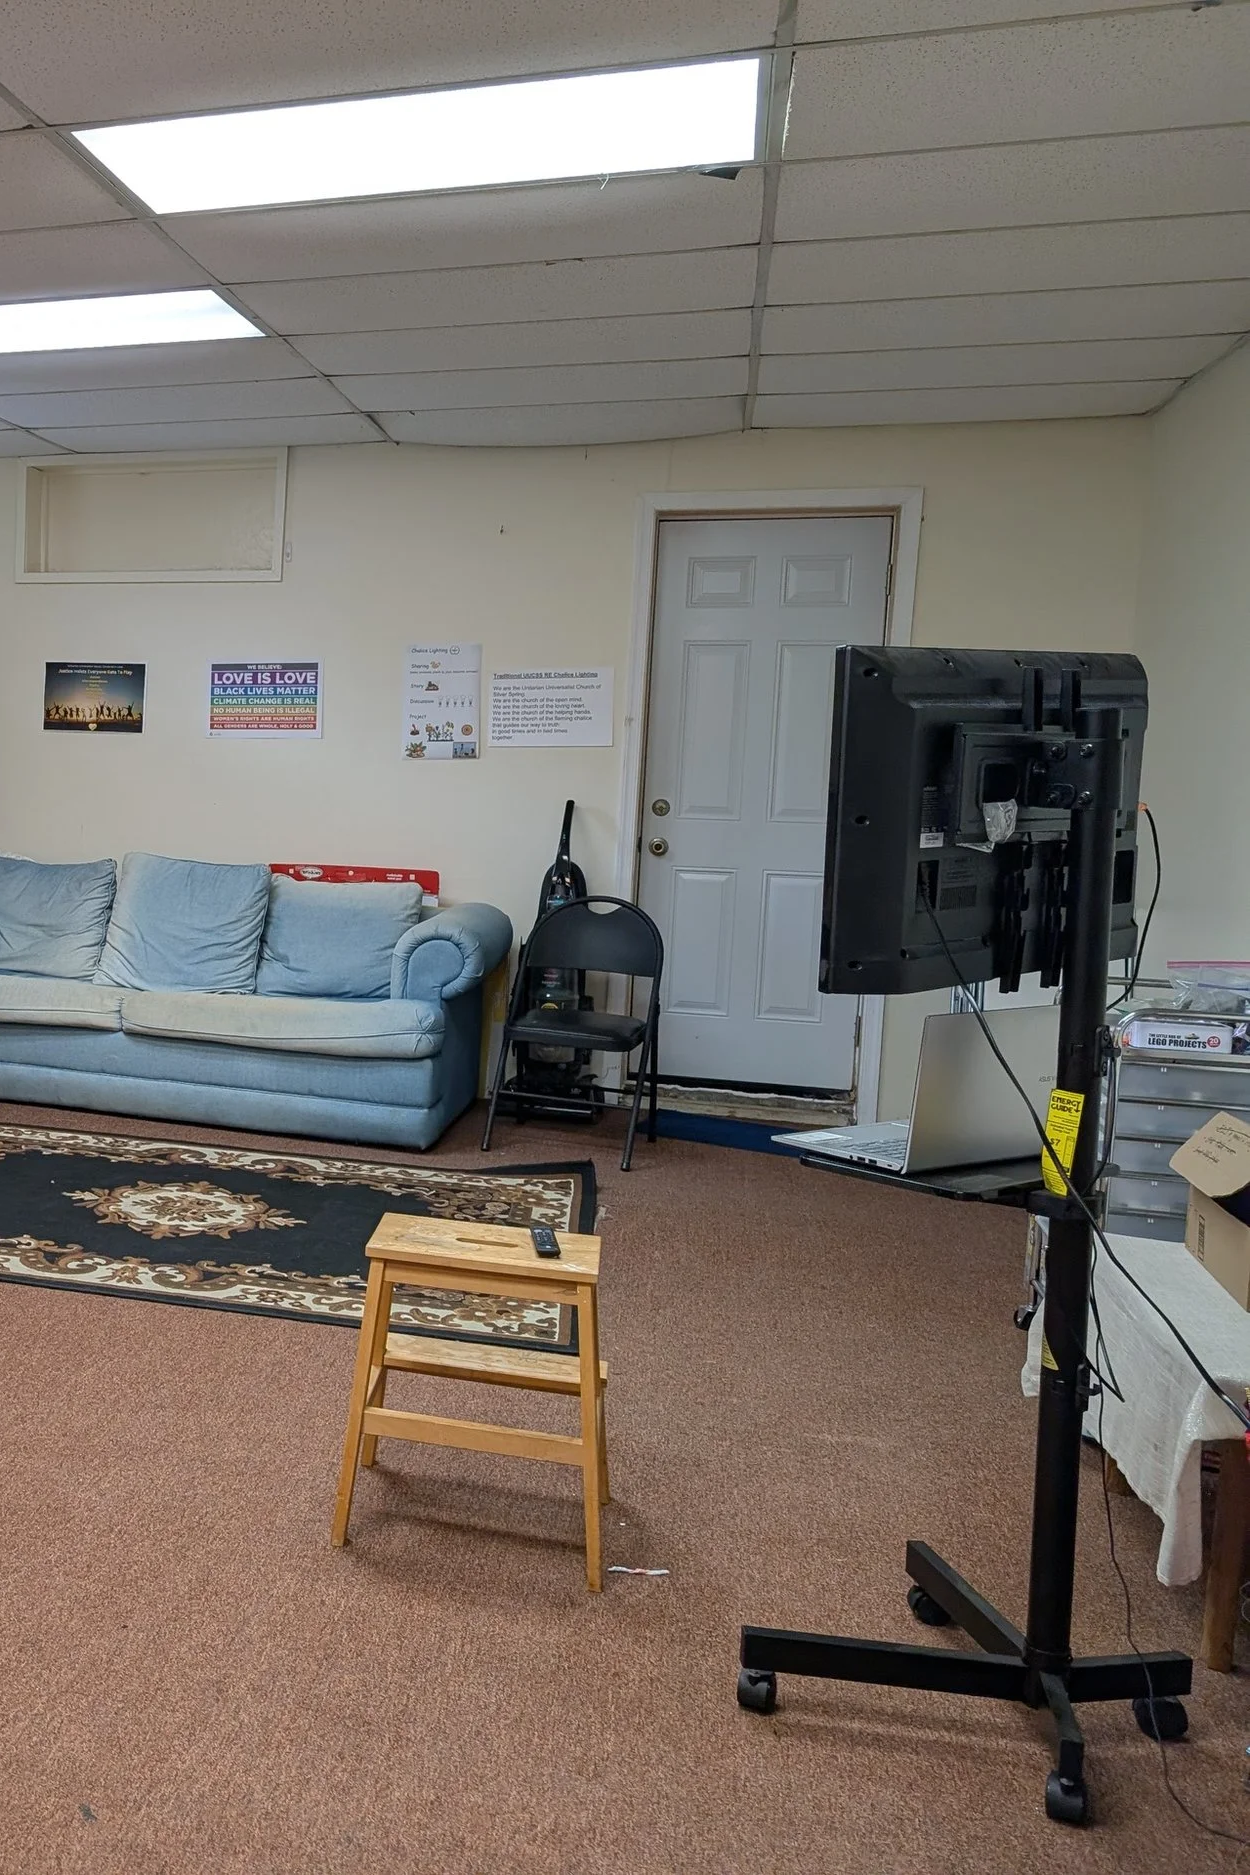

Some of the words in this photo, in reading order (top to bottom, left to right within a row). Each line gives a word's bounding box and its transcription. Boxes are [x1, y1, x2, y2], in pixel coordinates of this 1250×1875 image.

[214, 673, 253, 684] LOVE
[258, 673, 271, 684] IS
[276, 673, 316, 684] LOVE
[1169, 1039, 1207, 1049] PROJECTS
[1052, 1096, 1081, 1109] ENERGY
[1051, 1103, 1073, 1113] GUIDE
